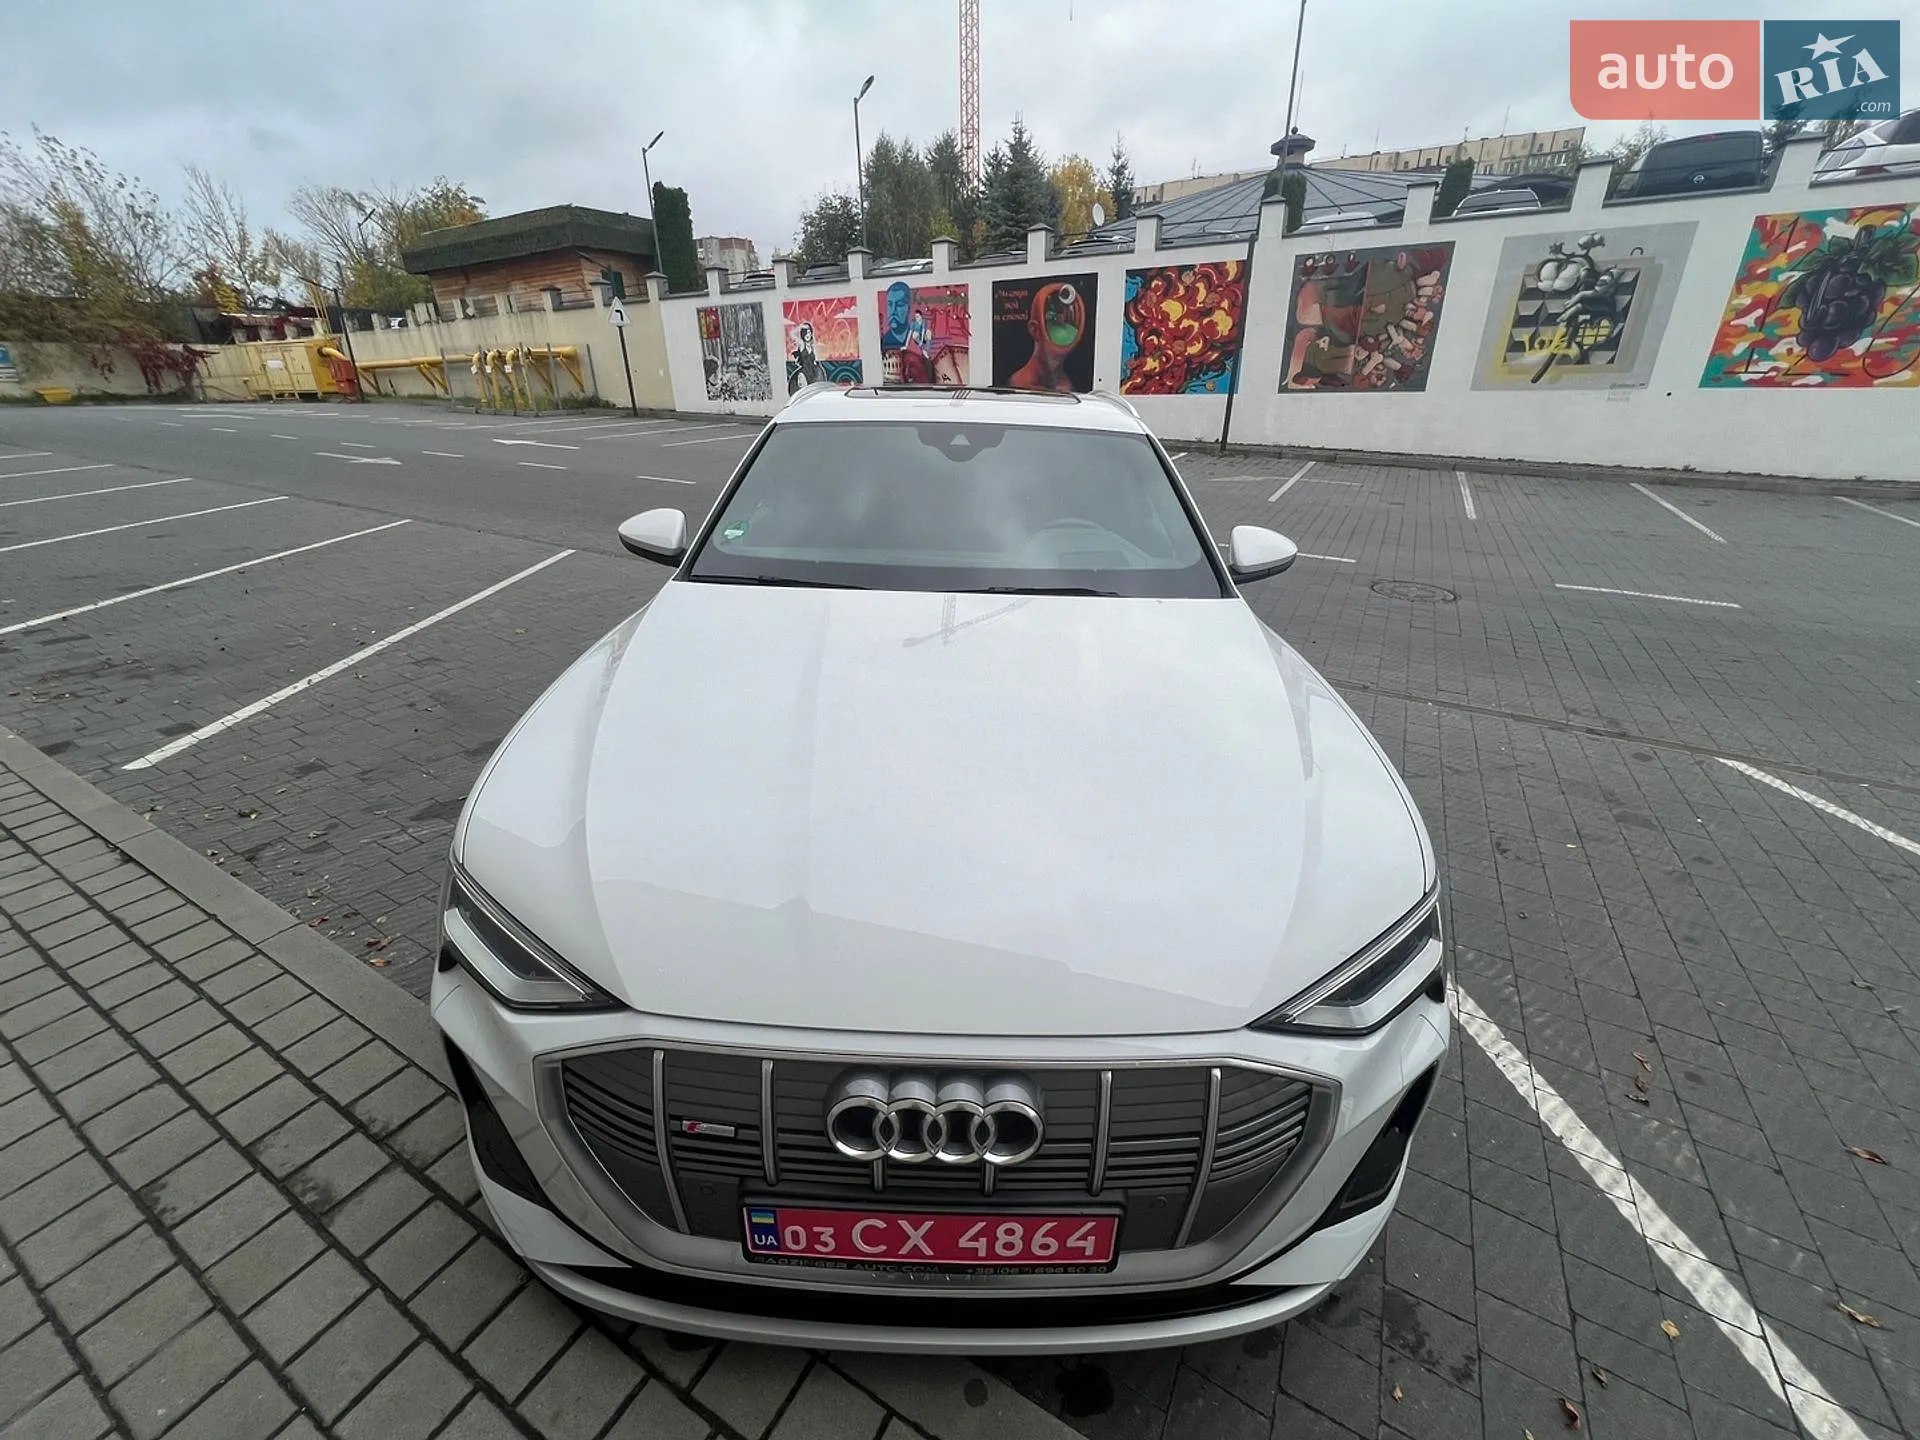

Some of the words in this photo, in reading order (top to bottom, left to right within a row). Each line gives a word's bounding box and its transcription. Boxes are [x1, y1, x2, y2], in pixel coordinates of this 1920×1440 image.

[754, 1234, 778, 1246] UA
[784, 1225, 836, 1253] 03
[851, 1218, 935, 1256] CX
[958, 1221, 1097, 1257] 4864
